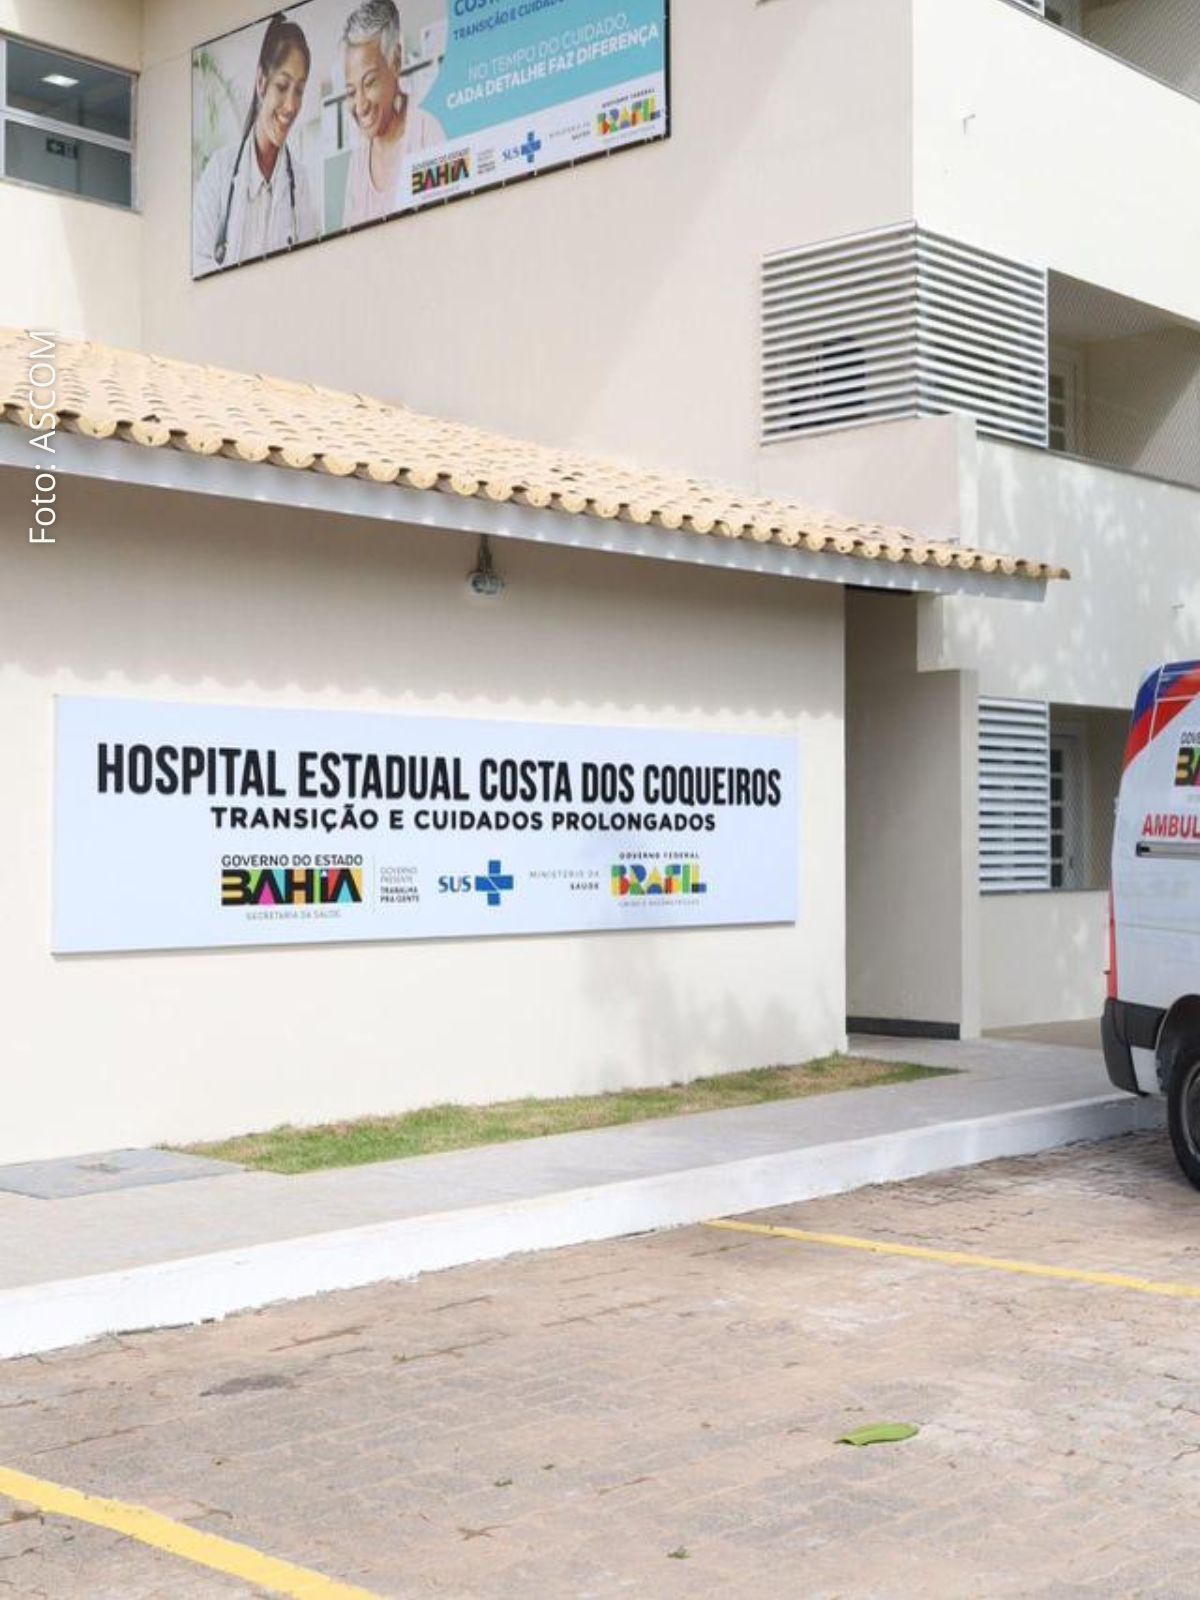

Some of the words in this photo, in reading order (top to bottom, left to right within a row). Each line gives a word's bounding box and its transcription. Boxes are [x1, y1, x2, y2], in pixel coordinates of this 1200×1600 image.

[510, 8, 517, 21] E
[446, 83, 484, 109] CADA
[485, 60, 547, 96] DETALHE
[549, 50, 575, 75] FAZ
[577, 22, 659, 65] DIFERENÇA
[468, 60, 488, 81] NO
[491, 44, 535, 76] TEMPO
[538, 36, 560, 58] DO
[97, 742, 287, 798] HOSPITAL
[298, 751, 470, 801] ESTADUAL
[479, 758, 573, 803] COSTA
[580, 762, 636, 805] DOS
[643, 763, 782, 808] COQUEIROS
[210, 803, 380, 834] TRANSIÇÃO
[389, 809, 405, 830] E
[413, 810, 543, 831] CUIDADOS
[551, 811, 717, 832] PROLONGADOS
[221, 854, 290, 868] GOVERNO
[292, 854, 312, 867] DO
[314, 854, 364, 867] ESTADO
[221, 868, 363, 906] BAHIA
[438, 874, 472, 893] SUS
